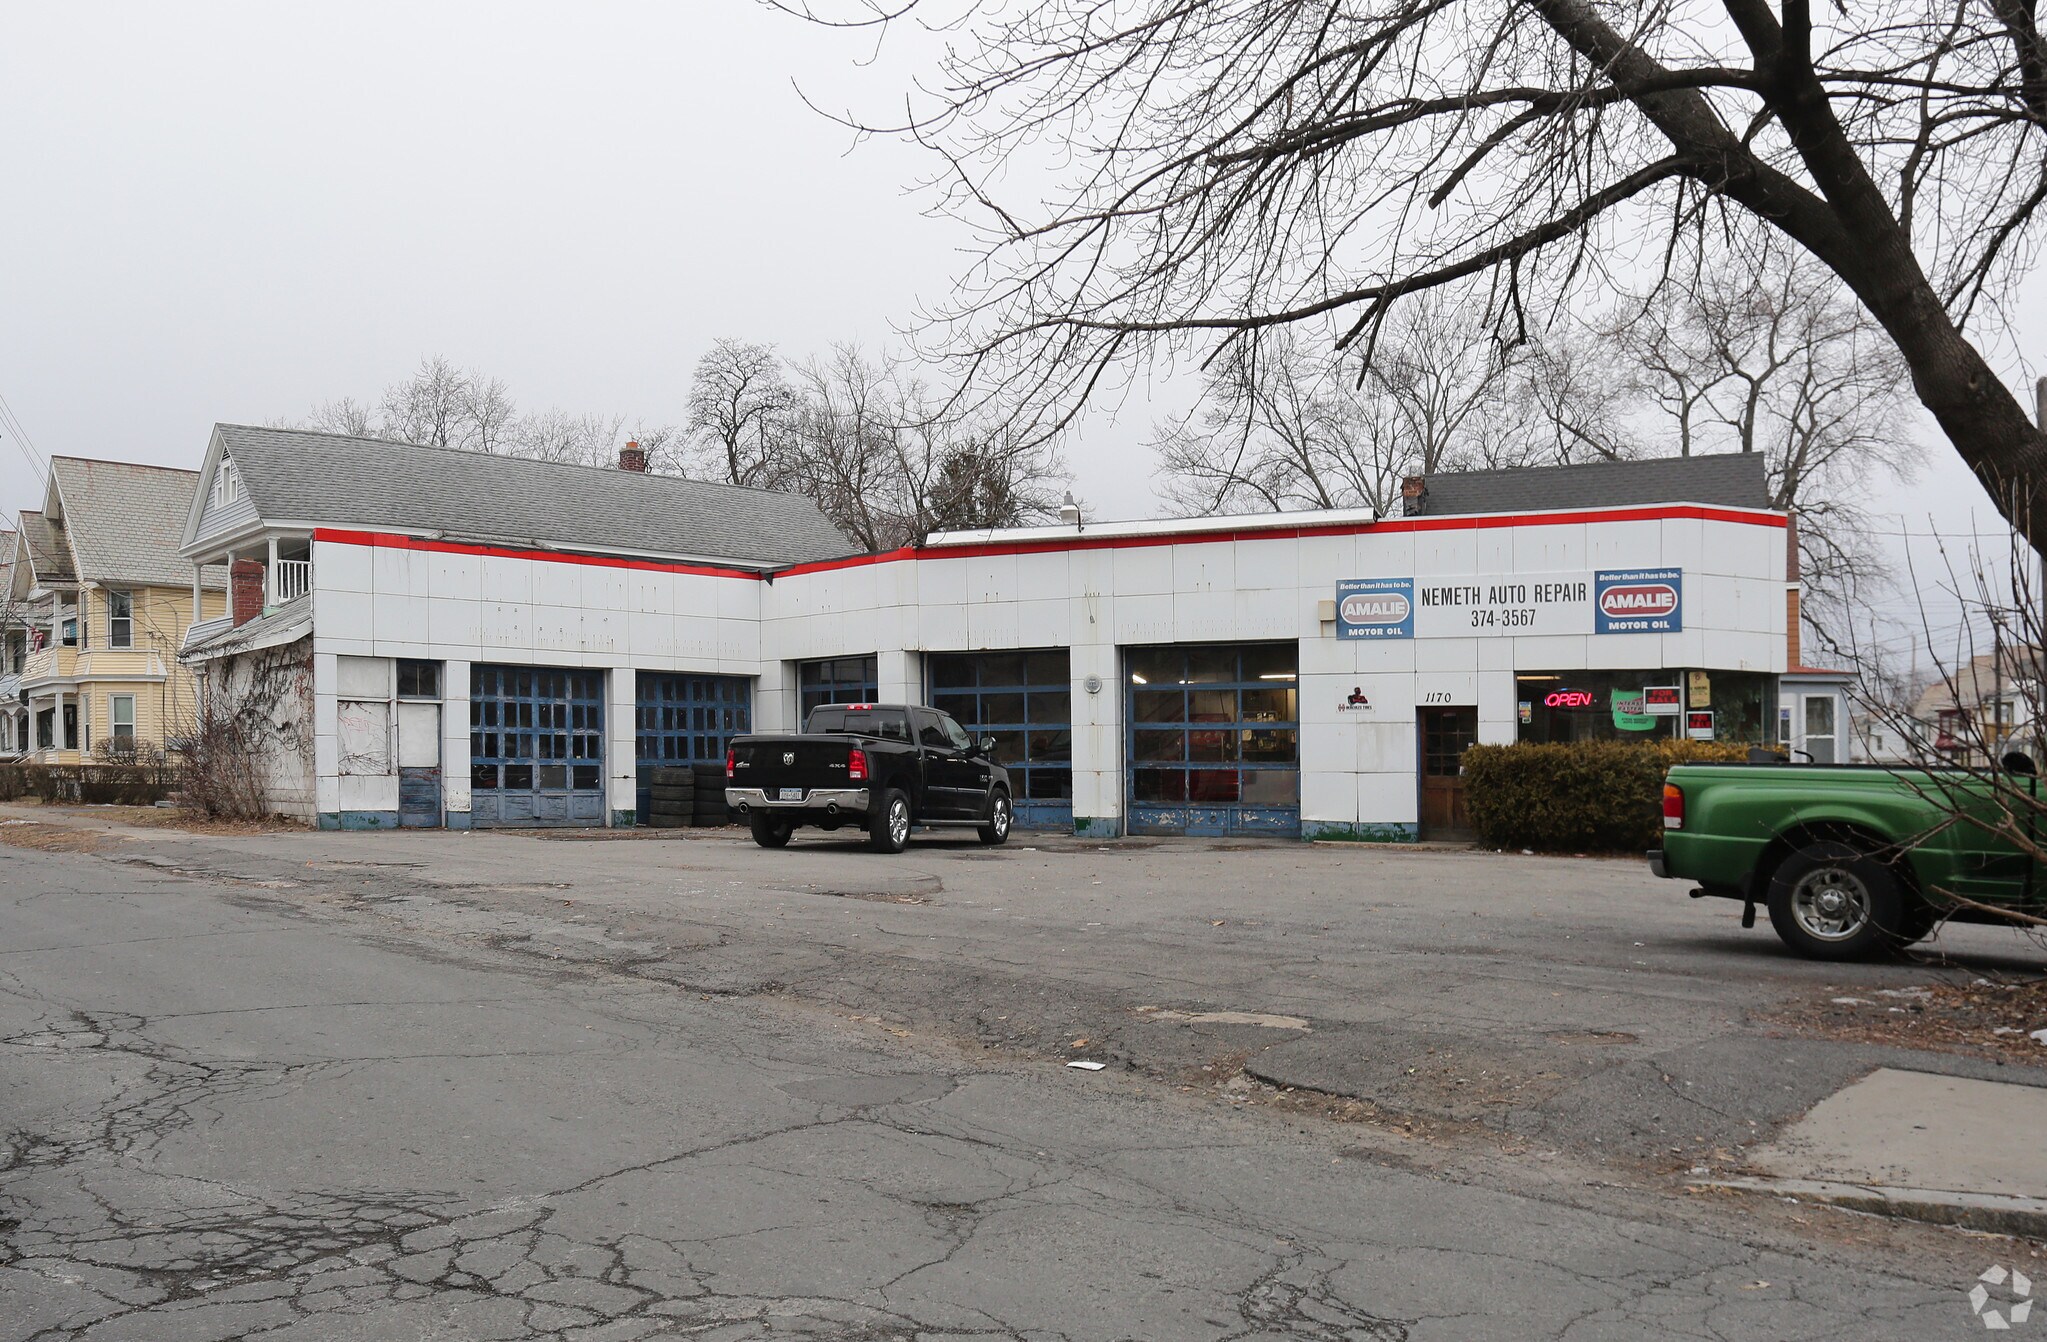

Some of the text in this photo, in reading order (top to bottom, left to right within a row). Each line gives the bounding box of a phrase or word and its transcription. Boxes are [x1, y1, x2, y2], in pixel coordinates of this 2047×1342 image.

[1421, 582, 1587, 606] NEMETH AUTO REPAIR
[1604, 592, 1673, 609] AMALIE
[1344, 601, 1405, 616] AMALIE
[1471, 609, 1536, 627] 374-3567
[1608, 620, 1670, 630] MOTOR OIL
[1348, 627, 1403, 636] MOTOR OIL
[1425, 692, 1452, 703] 1170
[1546, 692, 1593, 707] OPEN
